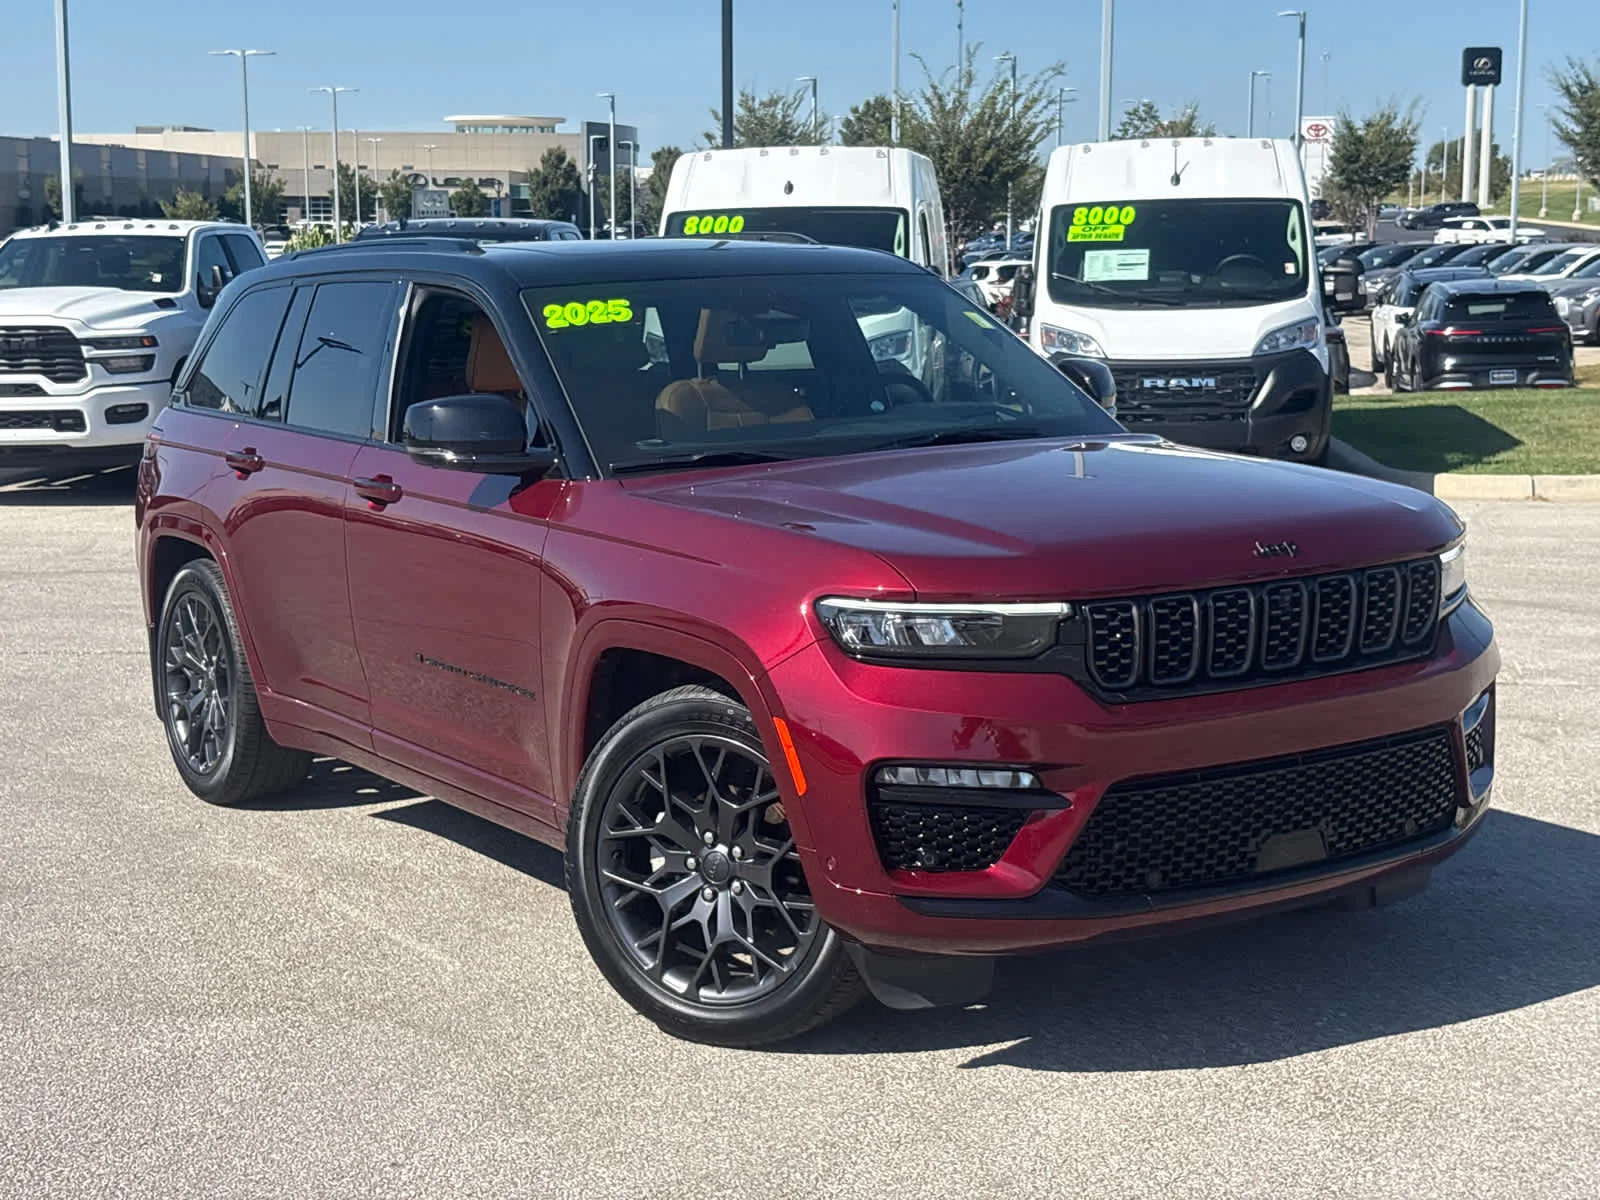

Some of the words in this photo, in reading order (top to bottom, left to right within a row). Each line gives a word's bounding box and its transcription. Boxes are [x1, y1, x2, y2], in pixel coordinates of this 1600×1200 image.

[683, 215, 745, 236] 8000
[1072, 206, 1136, 226] 8000
[543, 299, 633, 329] 2025
[1143, 377, 1216, 388] RAM
